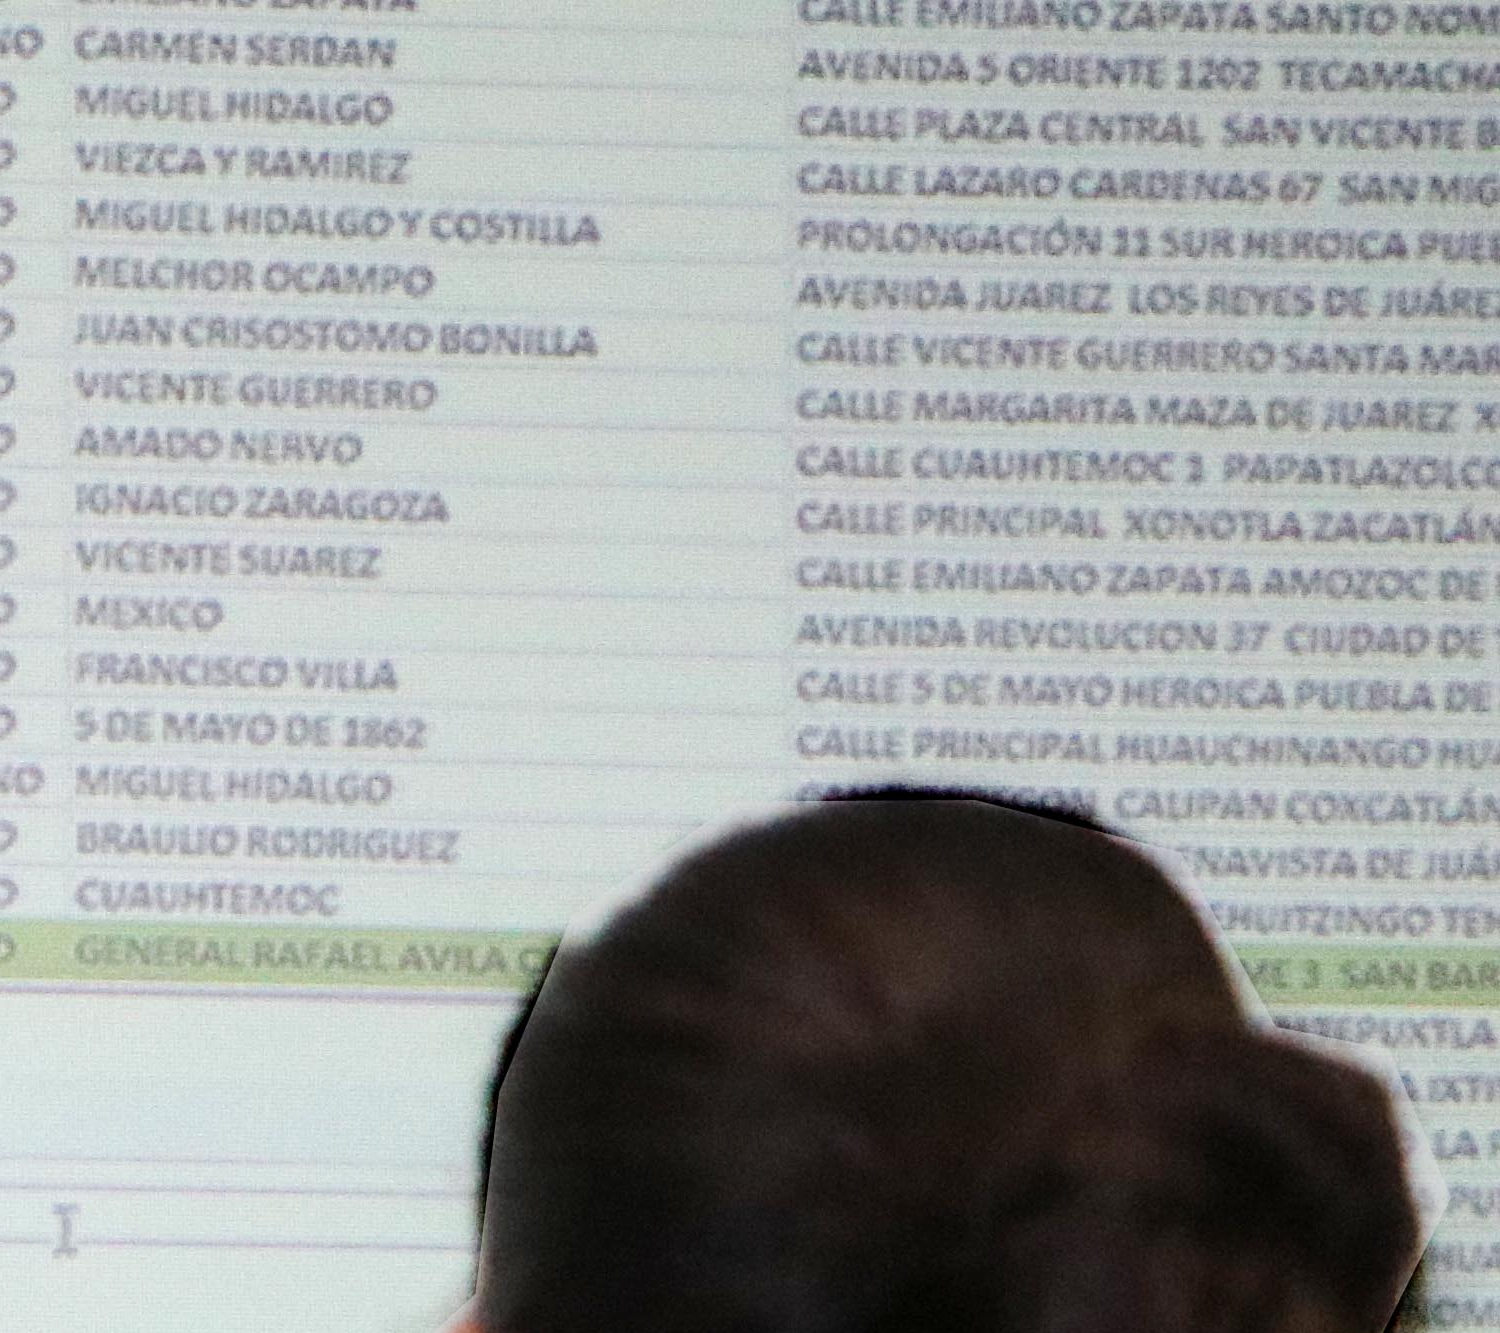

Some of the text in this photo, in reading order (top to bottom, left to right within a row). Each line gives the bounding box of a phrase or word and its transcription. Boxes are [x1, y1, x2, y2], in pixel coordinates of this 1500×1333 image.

[1265, 3, 1397, 36] SANTO
[73, 28, 239, 66] CARMEN
[245, 33, 398, 70] SERDAN
[796, 49, 971, 86] AVENIDA
[1005, 52, 1166, 91] ORIENTE
[1177, 56, 1263, 93] 1202
[796, 105, 905, 143] CALLE
[915, 109, 1032, 144] PLAZA
[1038, 111, 1205, 149] CENTRAL
[1221, 115, 1304, 149] SAN
[1307, 115, 1467, 152] VICENTE
[244, 146, 412, 186] RAMIREZ
[913, 165, 1070, 201] LAZARO
[1065, 168, 1273, 205] CARDENAS
[74, 197, 216, 237] MIGUEL
[223, 204, 397, 241] HIDALGO
[428, 209, 602, 248] COSTILLA
[798, 216, 1105, 258] PROLONGACIÓN
[1159, 227, 1236, 260] SUR
[1242, 229, 1410, 264] HEROICA
[74, 255, 255, 293] MELCHOR
[261, 261, 437, 300] OCAMPO
[796, 275, 970, 312] AVENIDA
[975, 280, 1113, 316] JUAREZ
[1127, 281, 1201, 317] LOS
[1203, 283, 1316, 321] REYES
[1322, 284, 1370, 320] DE
[74, 313, 176, 348] JUAN
[179, 314, 436, 356] CRISOSTOMO
[438, 322, 599, 360] BONILLA
[792, 331, 904, 368] CALLE
[911, 334, 1068, 372] VICENTE
[1074, 336, 1279, 375] GUERRERO
[1282, 341, 1412, 375] SANTA
[74, 369, 1459, 435] VICENTE GUERRERO MARGARITA MAZA JUAREZ
[74, 425, 224, 462] AMADO
[230, 428, 365, 467] NERVO
[911, 447, 1176, 485] CUAUHTEMOC
[75, 481, 240, 520] IGNACIO
[244, 486, 451, 525] ZARAGOZA
[794, 500, 903, 538] CALLE
[913, 503, 1107, 541] PRINCIPAL
[238, 544, 382, 581] SUAREZ
[912, 559, 1101, 597] EMILIANO
[1106, 563, 1253, 597] ZAPATA
[1437, 567, 1486, 603] DE
[75, 594, 225, 633] MEXICO
[974, 617, 1219, 655] REVOLUCION
[1225, 620, 1272, 655] 37
[1283, 622, 1433, 660] CIUDAD
[76, 652, 291, 690] FRANCISCO
[295, 659, 400, 693] VILLA
[940, 670, 990, 708] DE
[998, 673, 1116, 709] MAYO
[1293, 678, 1438, 715] PUEBLA
[104, 707, 154, 744] DE
[162, 710, 279, 747] MAYO
[343, 715, 428, 751] 1862
[794, 726, 904, 763] CALLE
[75, 764, 217, 803] MIGUEL
[224, 769, 395, 807] HIDALGO
[76, 821, 241, 859] BRAULIO
[246, 825, 461, 865] RODRIGUEZ
[73, 878, 339, 920] CUAUHTEMOC
[78, 940, 248, 975] GENERAL
[253, 942, 389, 977] RAFAEL
[399, 947, 509, 981] AVILA
